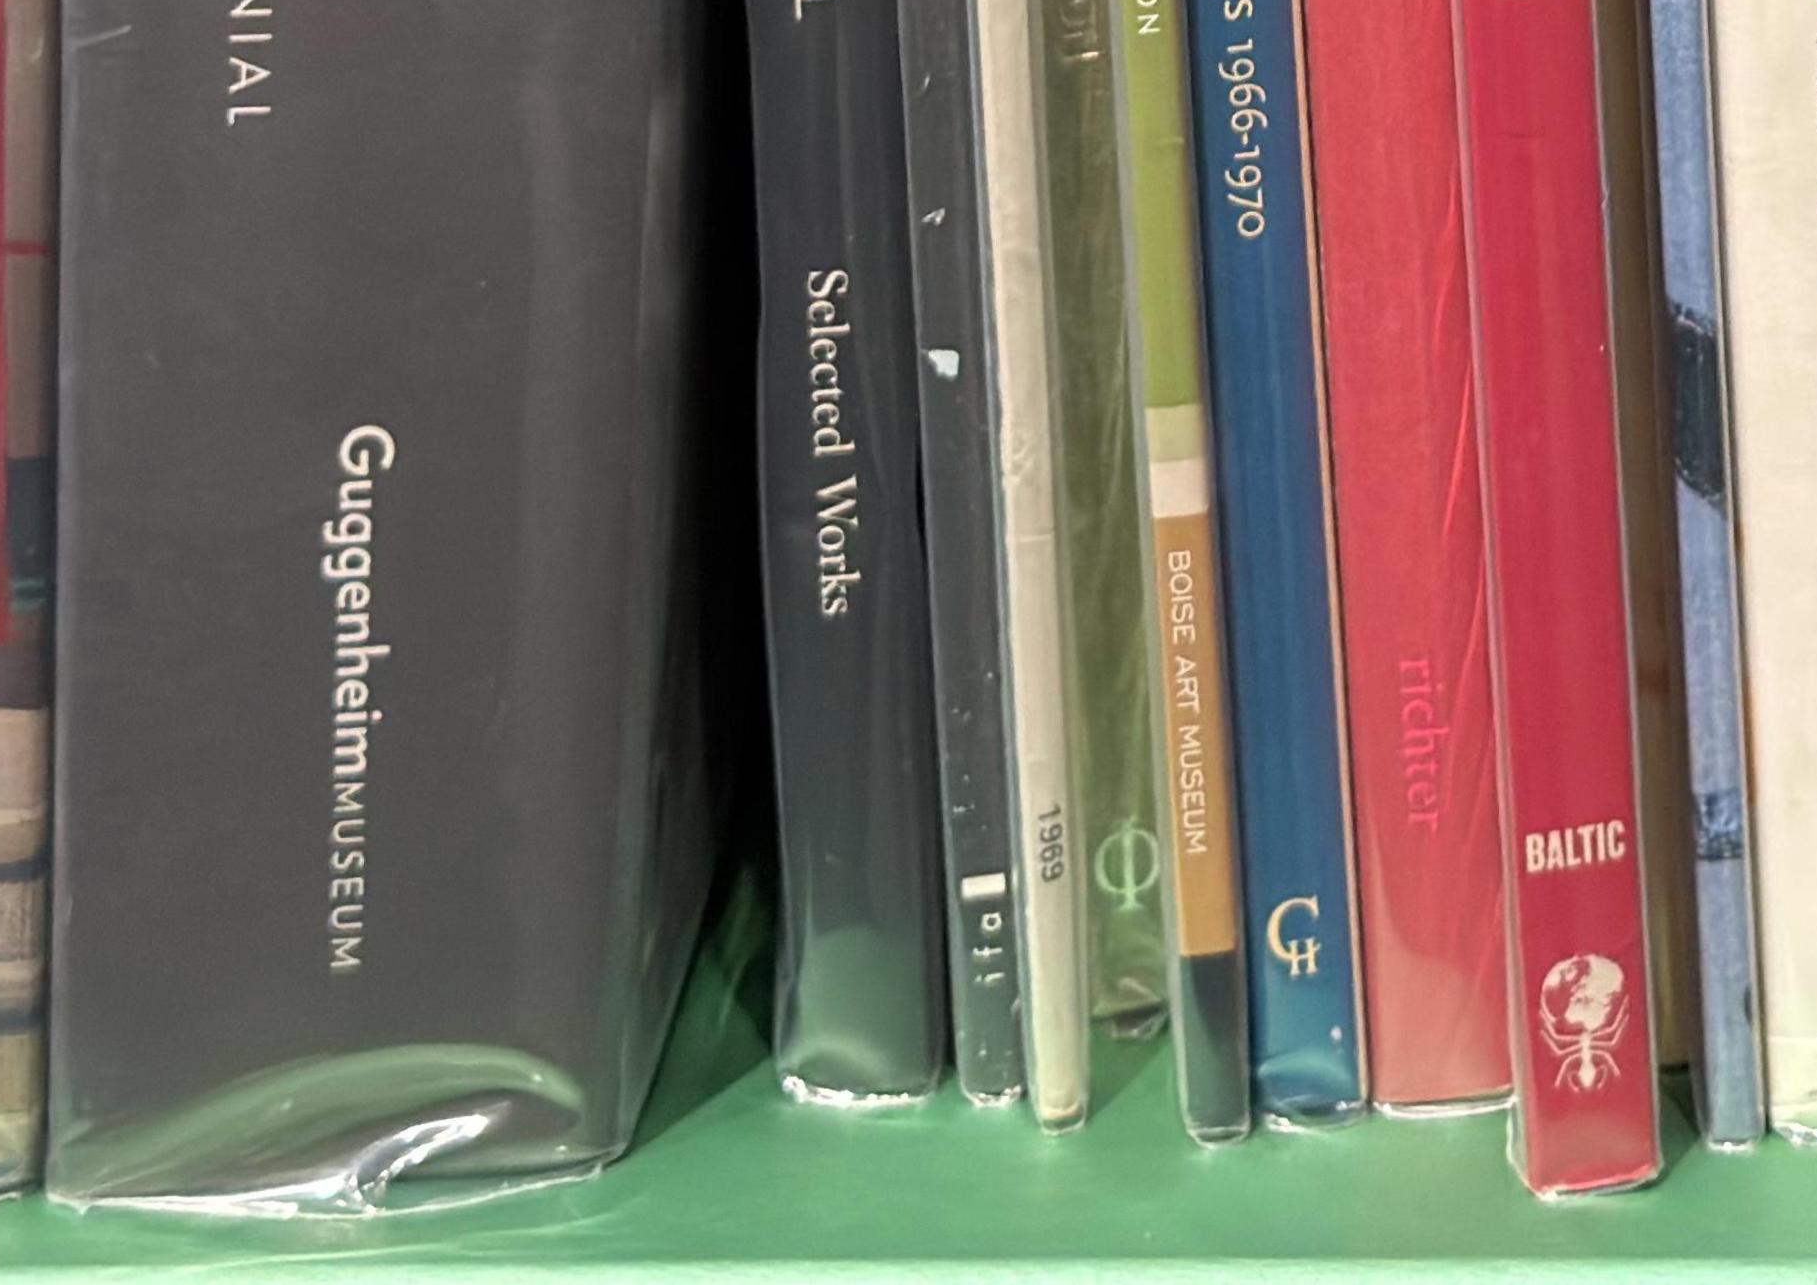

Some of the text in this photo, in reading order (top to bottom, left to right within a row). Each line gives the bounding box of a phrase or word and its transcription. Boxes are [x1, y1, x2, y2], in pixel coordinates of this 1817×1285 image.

[806, 268, 860, 617] Selected Works
[1167, 550, 1206, 855] BOISE MUSEUM
[1526, 820, 1626, 873] BALTIC
